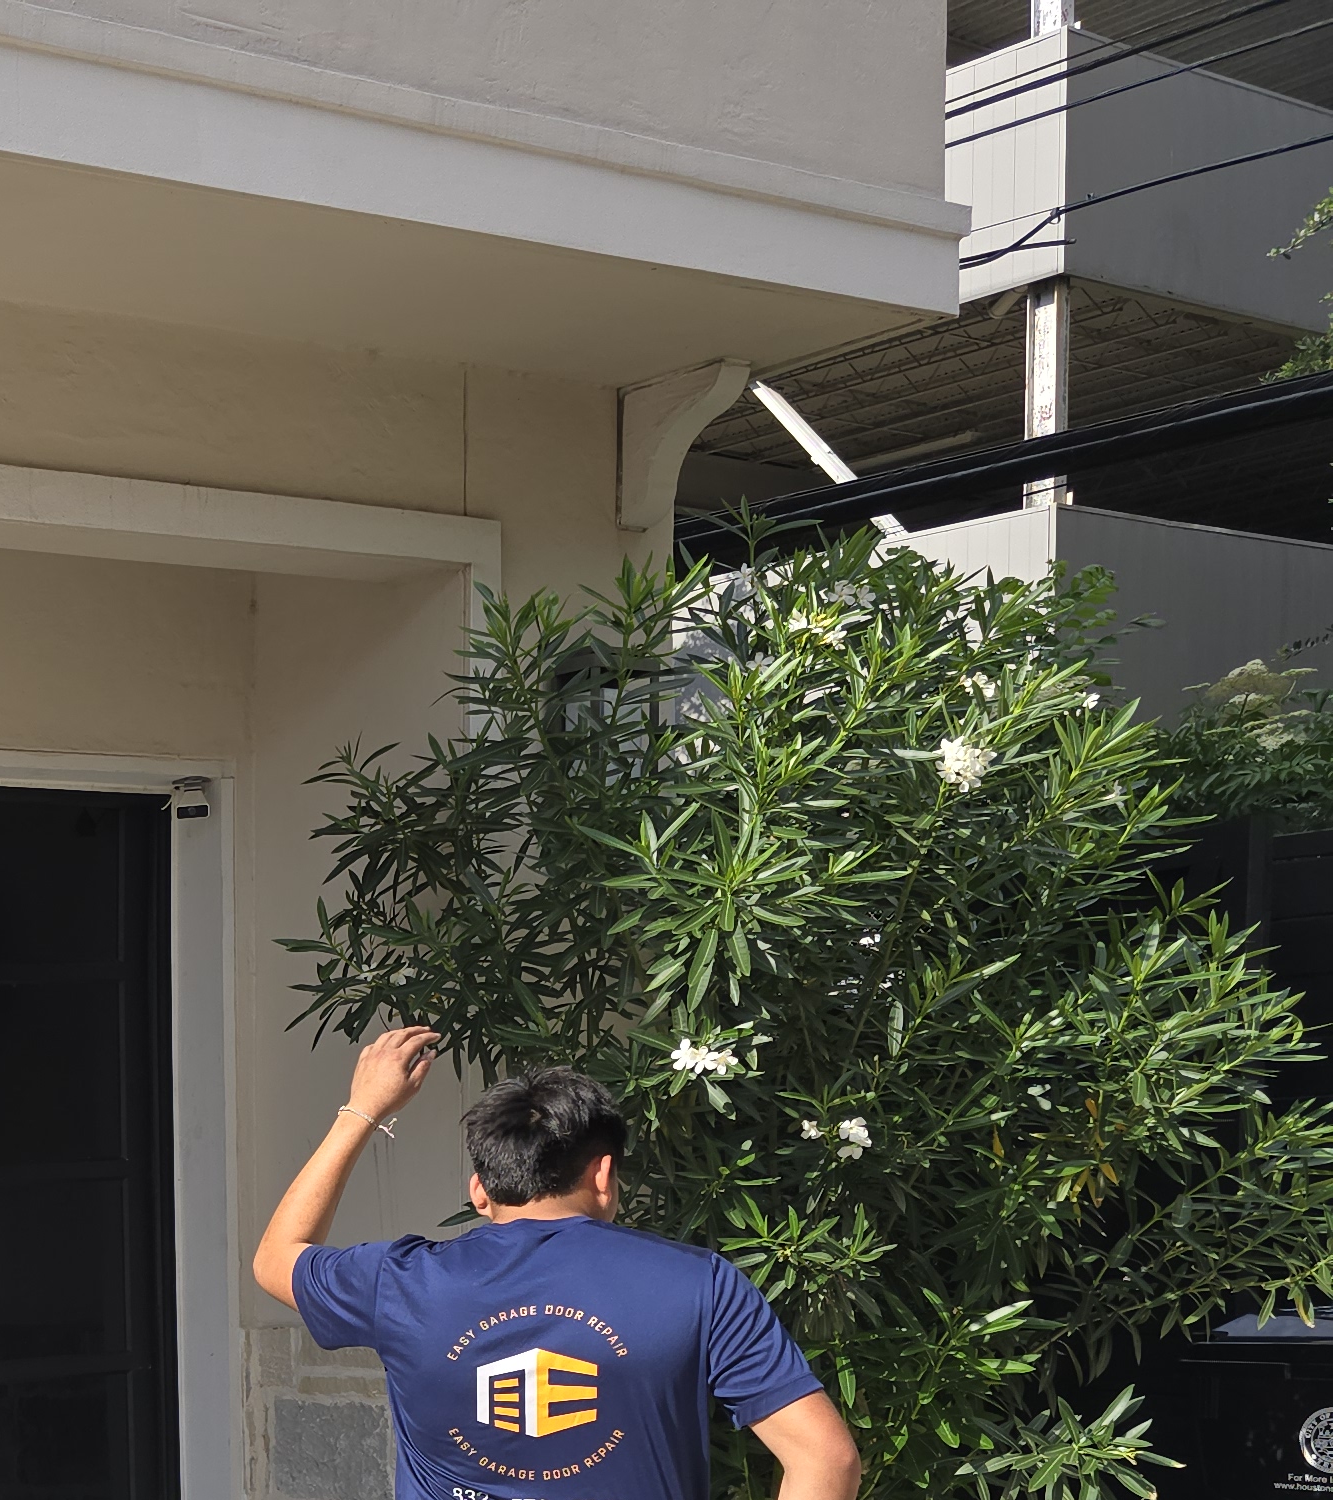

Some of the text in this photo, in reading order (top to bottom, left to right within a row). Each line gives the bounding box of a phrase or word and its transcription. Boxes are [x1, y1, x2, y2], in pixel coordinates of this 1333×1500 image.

[447, 1304, 628, 1361] EASY GARAGE DOOR REPAIR
[448, 1427, 625, 1481] EASY GARAGE DOOR REPAIR
[1287, 1473, 1303, 1482] For
[1304, 1474, 1328, 1484] More
